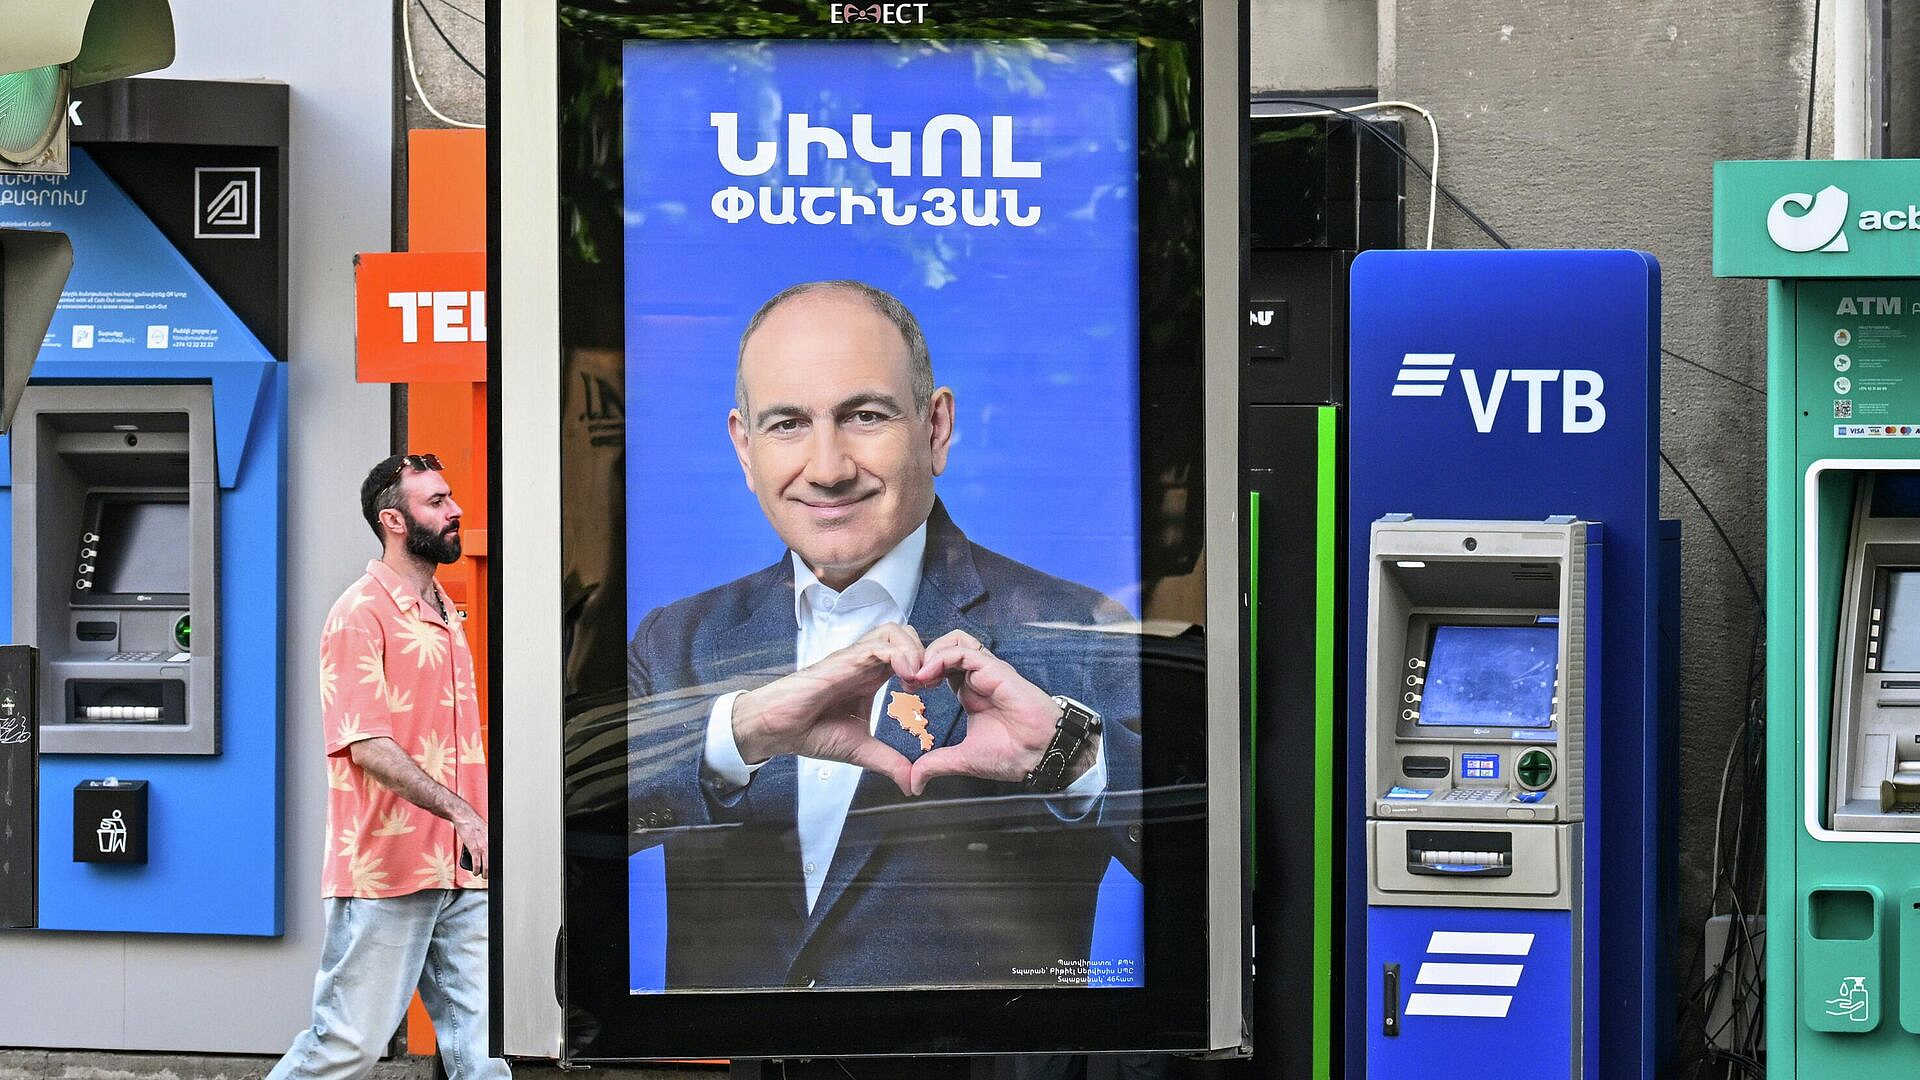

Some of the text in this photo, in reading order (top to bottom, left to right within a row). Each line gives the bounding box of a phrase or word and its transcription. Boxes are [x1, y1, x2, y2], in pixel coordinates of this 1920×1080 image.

[710, 112, 1042, 178] ՆԻԿՈԼ
[711, 186, 1042, 227] ՓԱՇԻՆՅԱՆ
[1836, 297, 1901, 315] ATM
[1459, 369, 1606, 433] VTB
